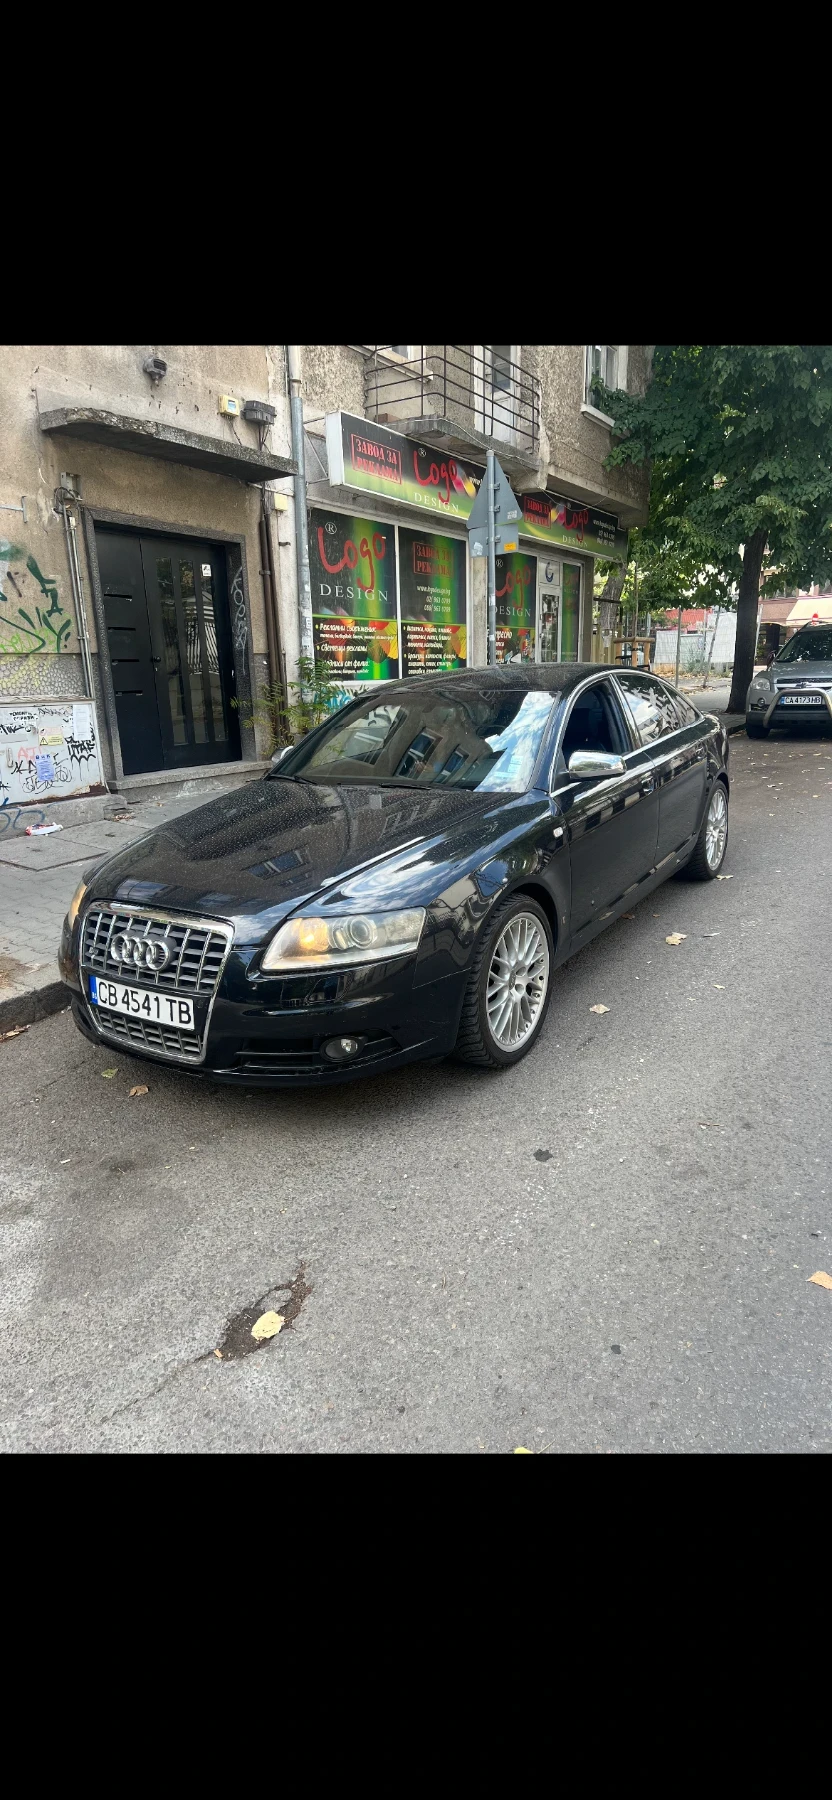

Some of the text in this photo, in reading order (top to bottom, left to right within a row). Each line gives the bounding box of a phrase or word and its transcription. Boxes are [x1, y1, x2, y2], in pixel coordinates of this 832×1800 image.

[356, 438, 397, 465] ЗАВОД ЗА
[356, 456, 399, 481] РЕКЛАМА
[413, 450, 457, 503] Logo
[414, 491, 459, 513] DESIGN
[563, 504, 588, 542] Logo
[317, 527, 385, 594] Logo
[319, 584, 388, 602] DESIGN
[98, 981, 192, 1025] CB 4541 TB
